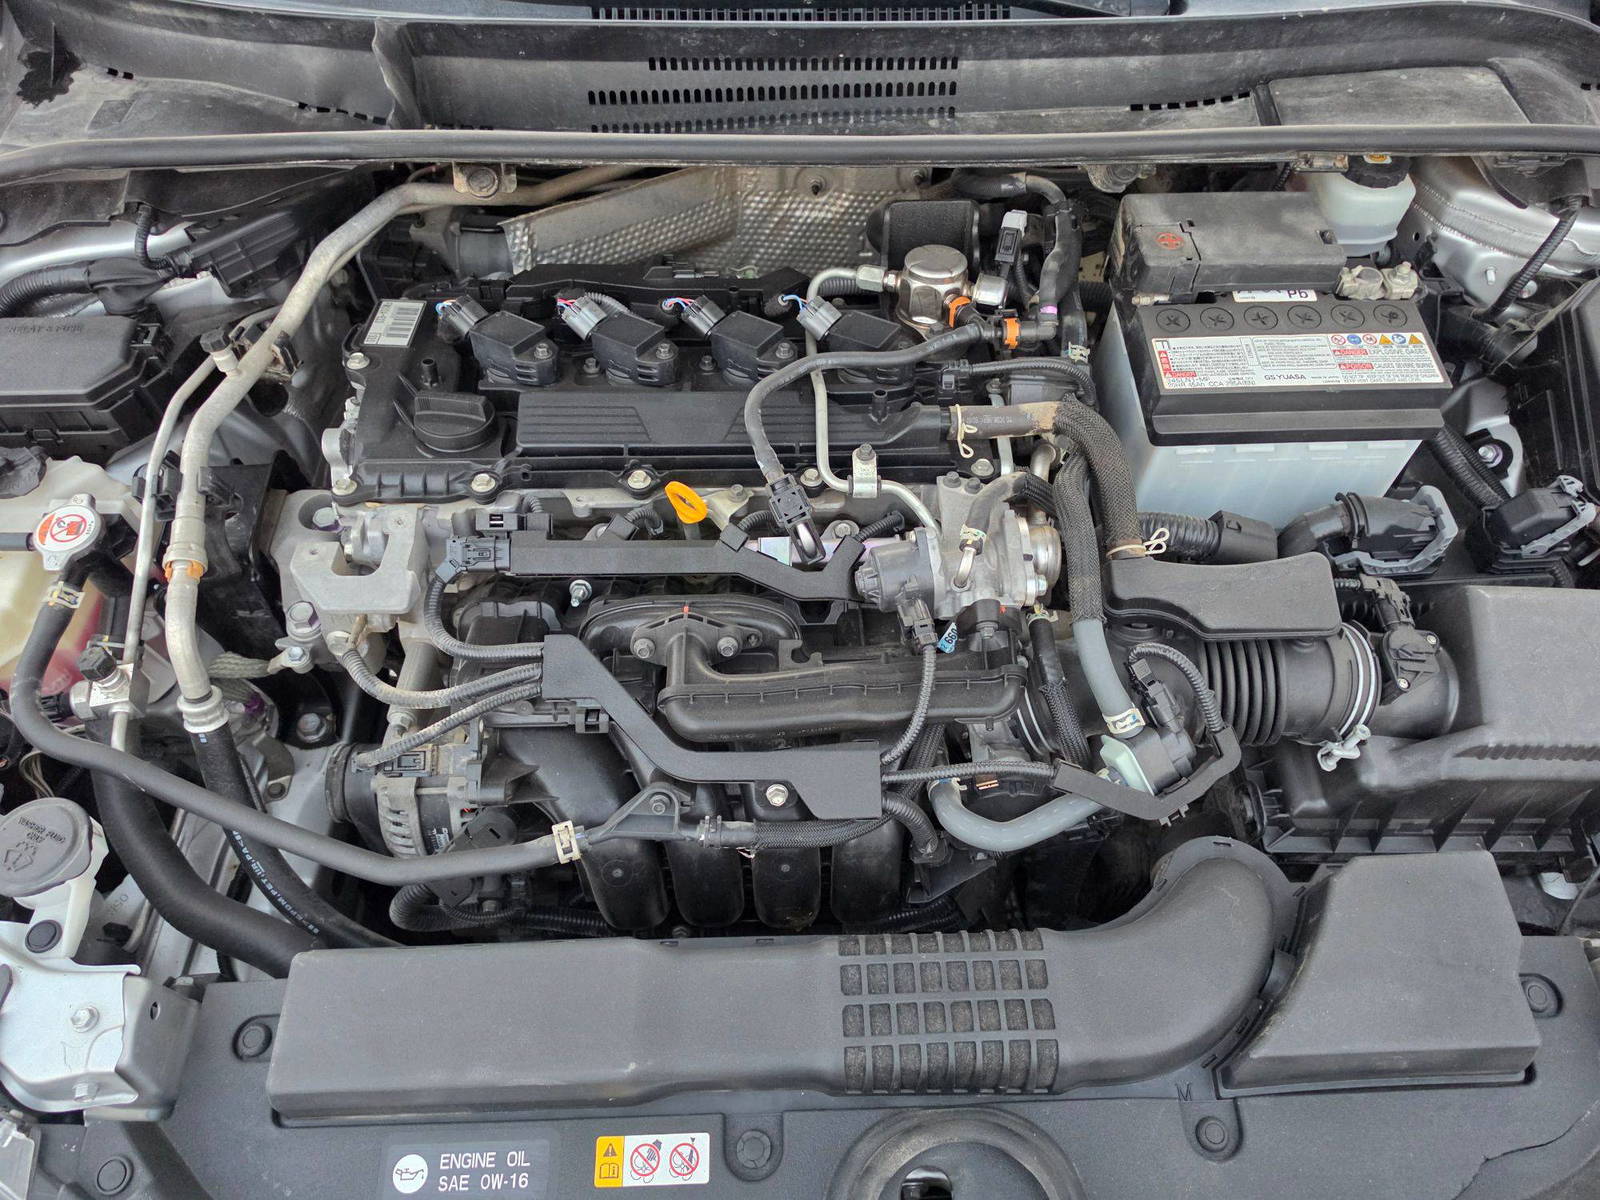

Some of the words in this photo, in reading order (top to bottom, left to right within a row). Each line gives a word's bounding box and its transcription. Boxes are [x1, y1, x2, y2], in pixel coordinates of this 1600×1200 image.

[1276, 373, 1307, 381] YUASA
[439, 1151, 496, 1170] ENGINE
[506, 1150, 531, 1168] OIL
[437, 1174, 470, 1192] SAE
[480, 1172, 529, 1190] 0W-16
